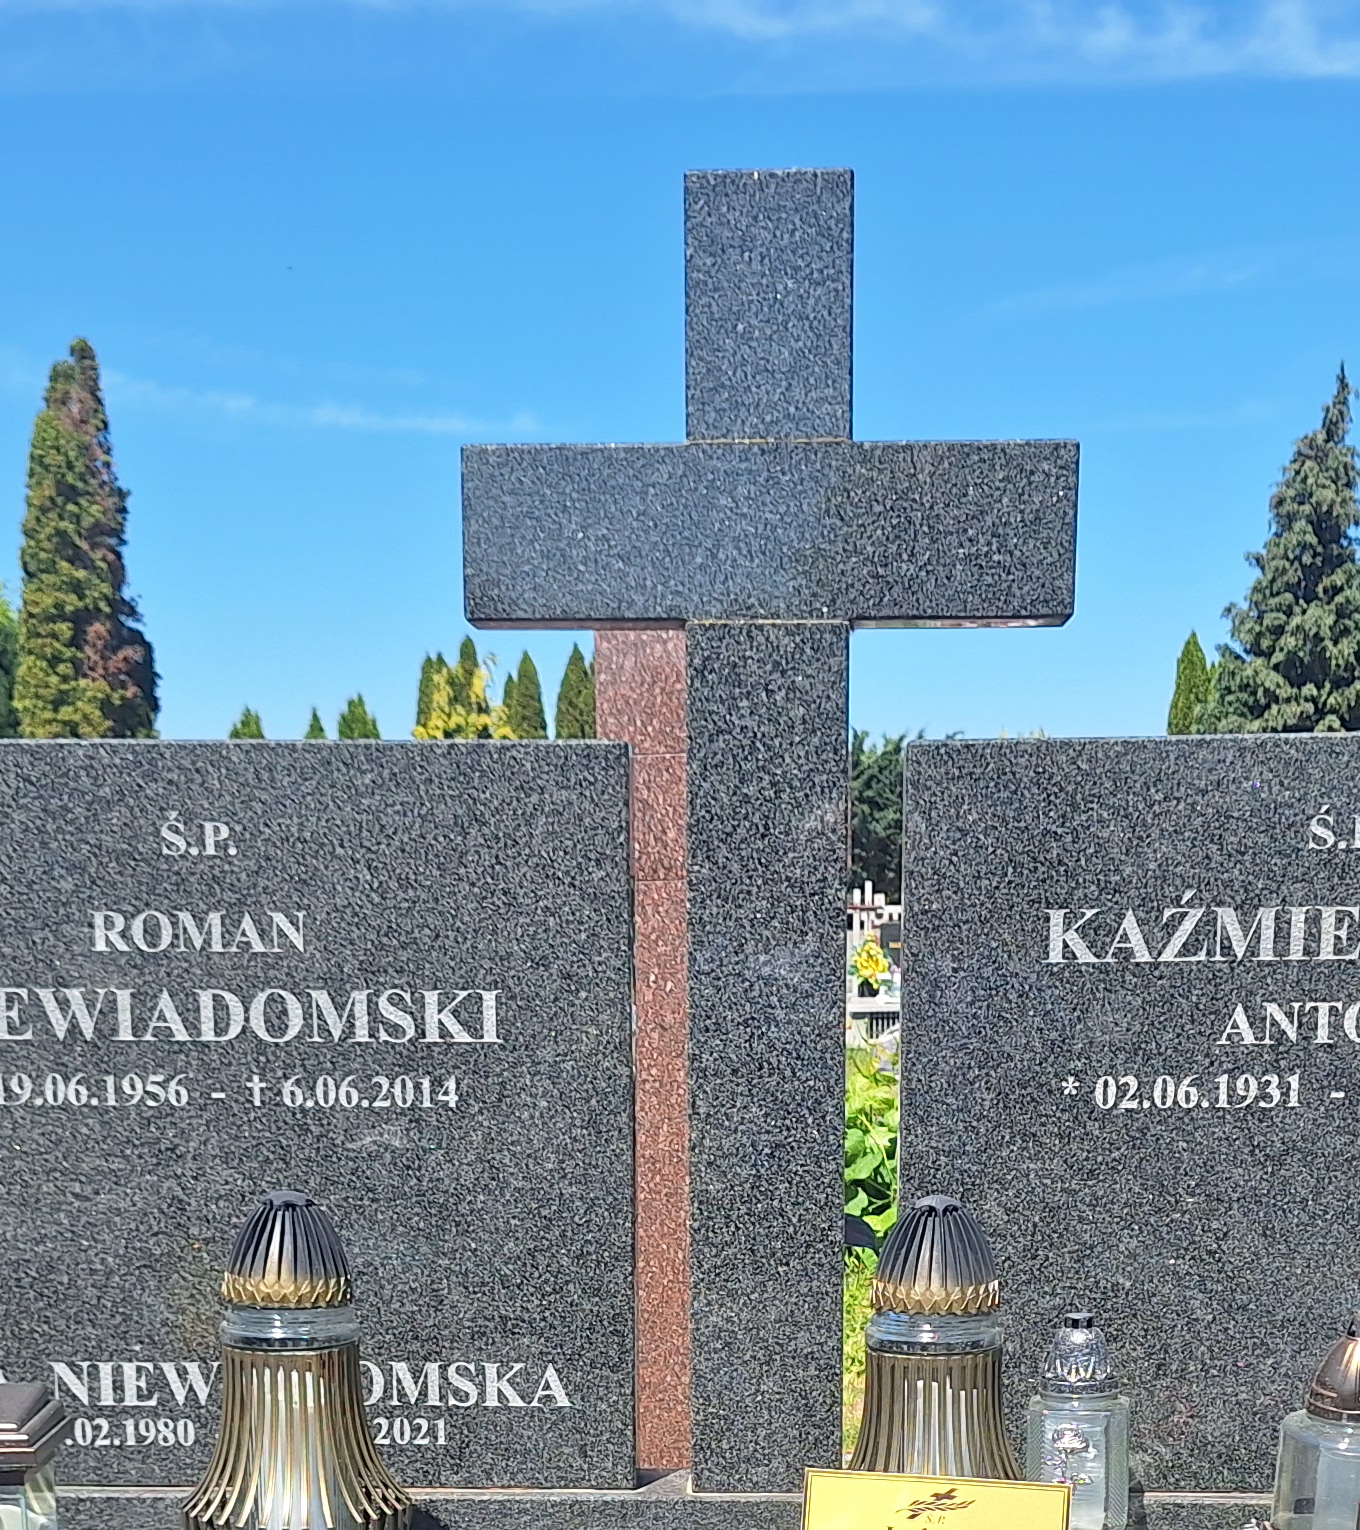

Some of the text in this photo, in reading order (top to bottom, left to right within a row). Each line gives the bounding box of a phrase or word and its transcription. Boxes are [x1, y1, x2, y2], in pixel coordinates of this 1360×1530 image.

[160, 810, 238, 856] Ś.P.
[90, 911, 306, 954] ROMAN
[1095, 1074, 1301, 1109] 02.06.1931
[48, 1360, 572, 1407] NIEWOMSKA
[63, 1418, 195, 1448] .02.1980
